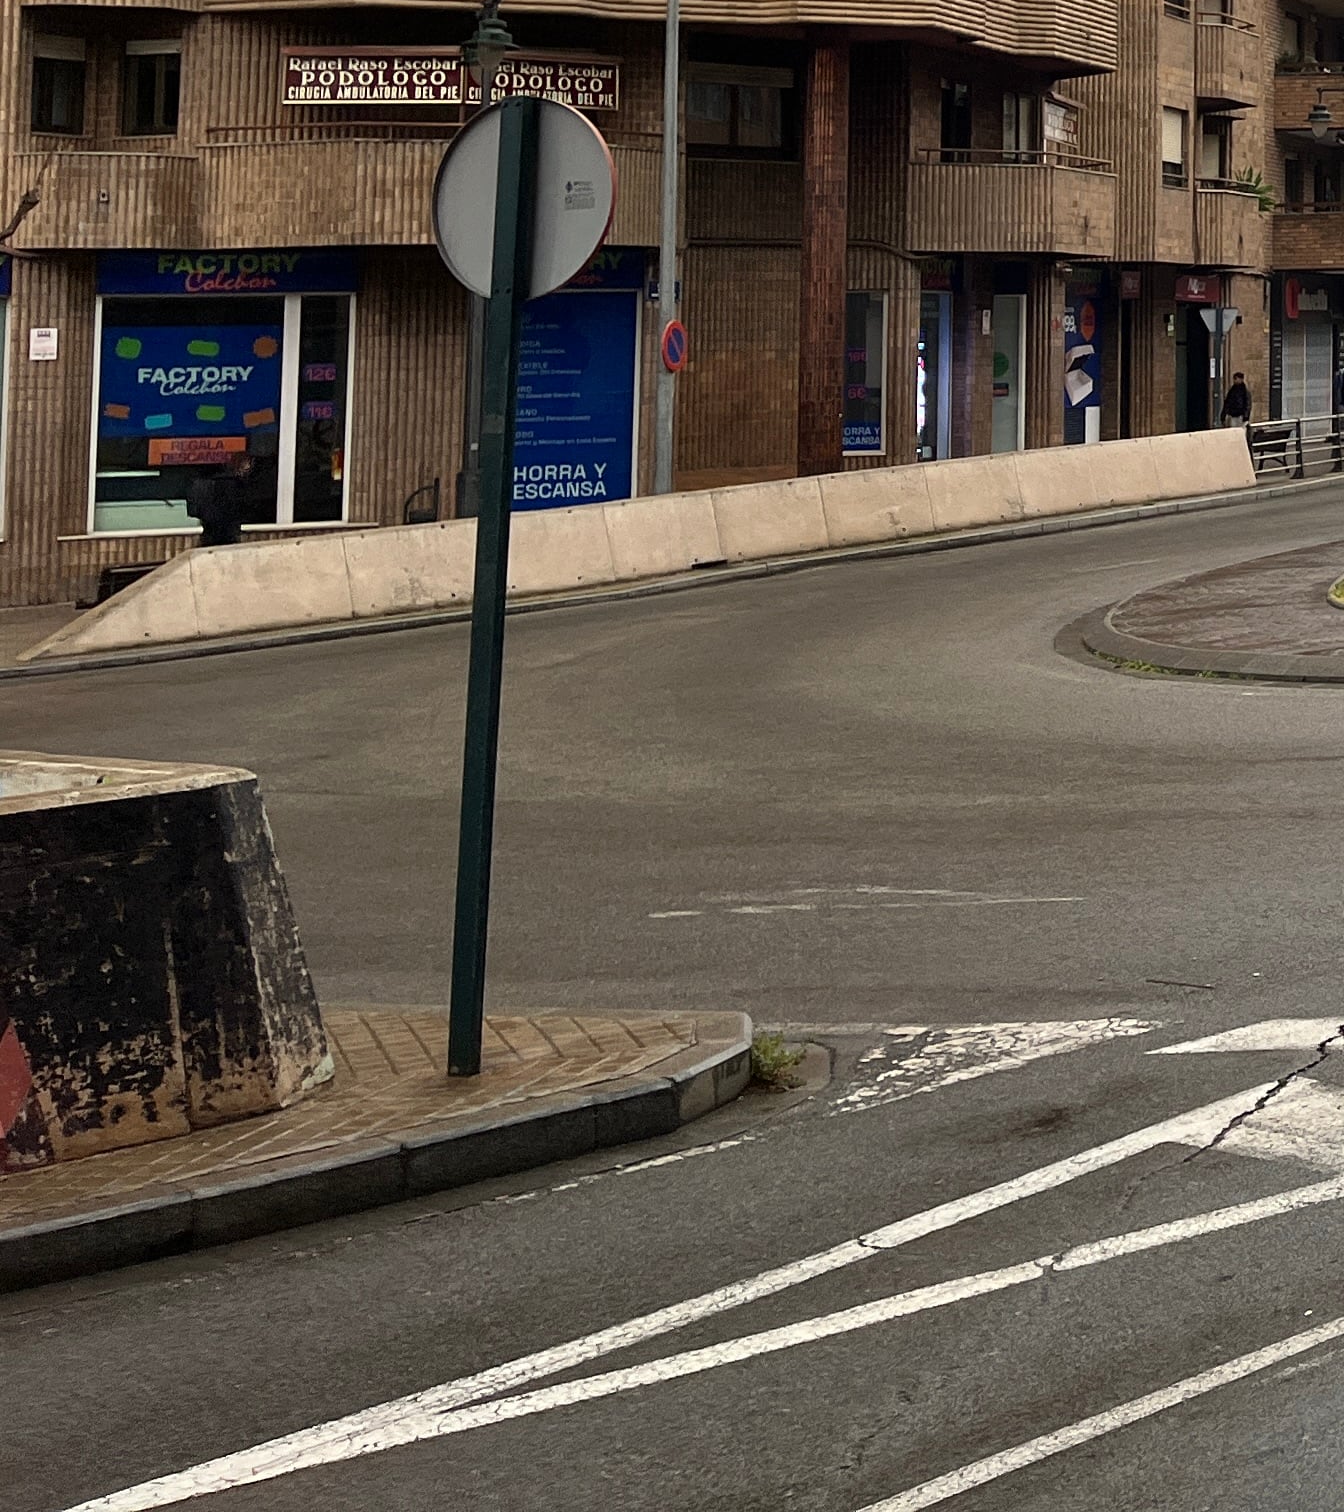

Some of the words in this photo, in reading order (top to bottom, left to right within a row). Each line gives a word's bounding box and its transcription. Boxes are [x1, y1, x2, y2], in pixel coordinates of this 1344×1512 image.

[289, 57, 342, 71] Rafael
[348, 57, 388, 71] Raso
[393, 58, 458, 71] Escobar
[520, 61, 554, 75] Raso
[558, 63, 613, 79] Escobar
[301, 70, 447, 86] PODOLOGO
[495, 72, 604, 93] ODOLOGO
[288, 86, 332, 100] CIRUGIA
[336, 86, 409, 100] AMBULATORIA
[414, 86, 436, 99] DEL
[440, 86, 459, 99] PIE
[577, 93, 594, 106] DEL
[599, 93, 614, 107] PIE
[157, 253, 300, 274] FACTORY
[138, 366, 254, 384] FACTORY
[513, 463, 587, 483] HORRA
[593, 462, 607, 479] Y
[513, 481, 607, 501] ESCANSA
